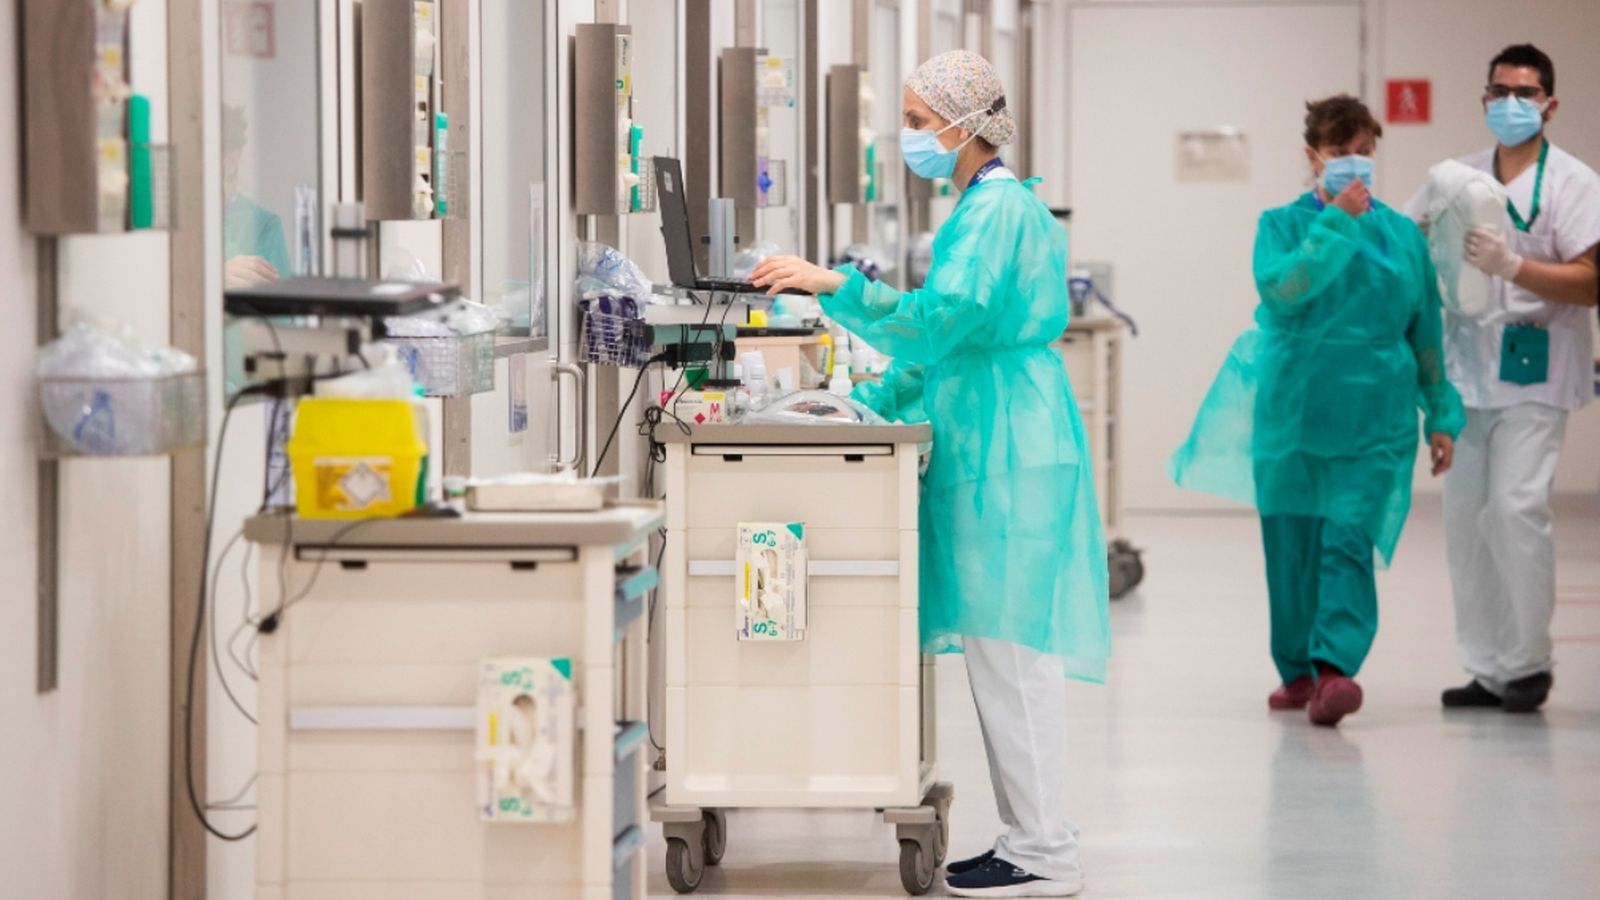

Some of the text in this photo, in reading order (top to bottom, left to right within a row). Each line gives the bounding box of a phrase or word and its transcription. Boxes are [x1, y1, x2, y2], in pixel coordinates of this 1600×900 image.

[710, 402, 720, 416] M
[752, 532, 767, 544] S
[767, 529, 777, 547] 6-7
[752, 622, 767, 634] S
[768, 620, 778, 637] 6-7
